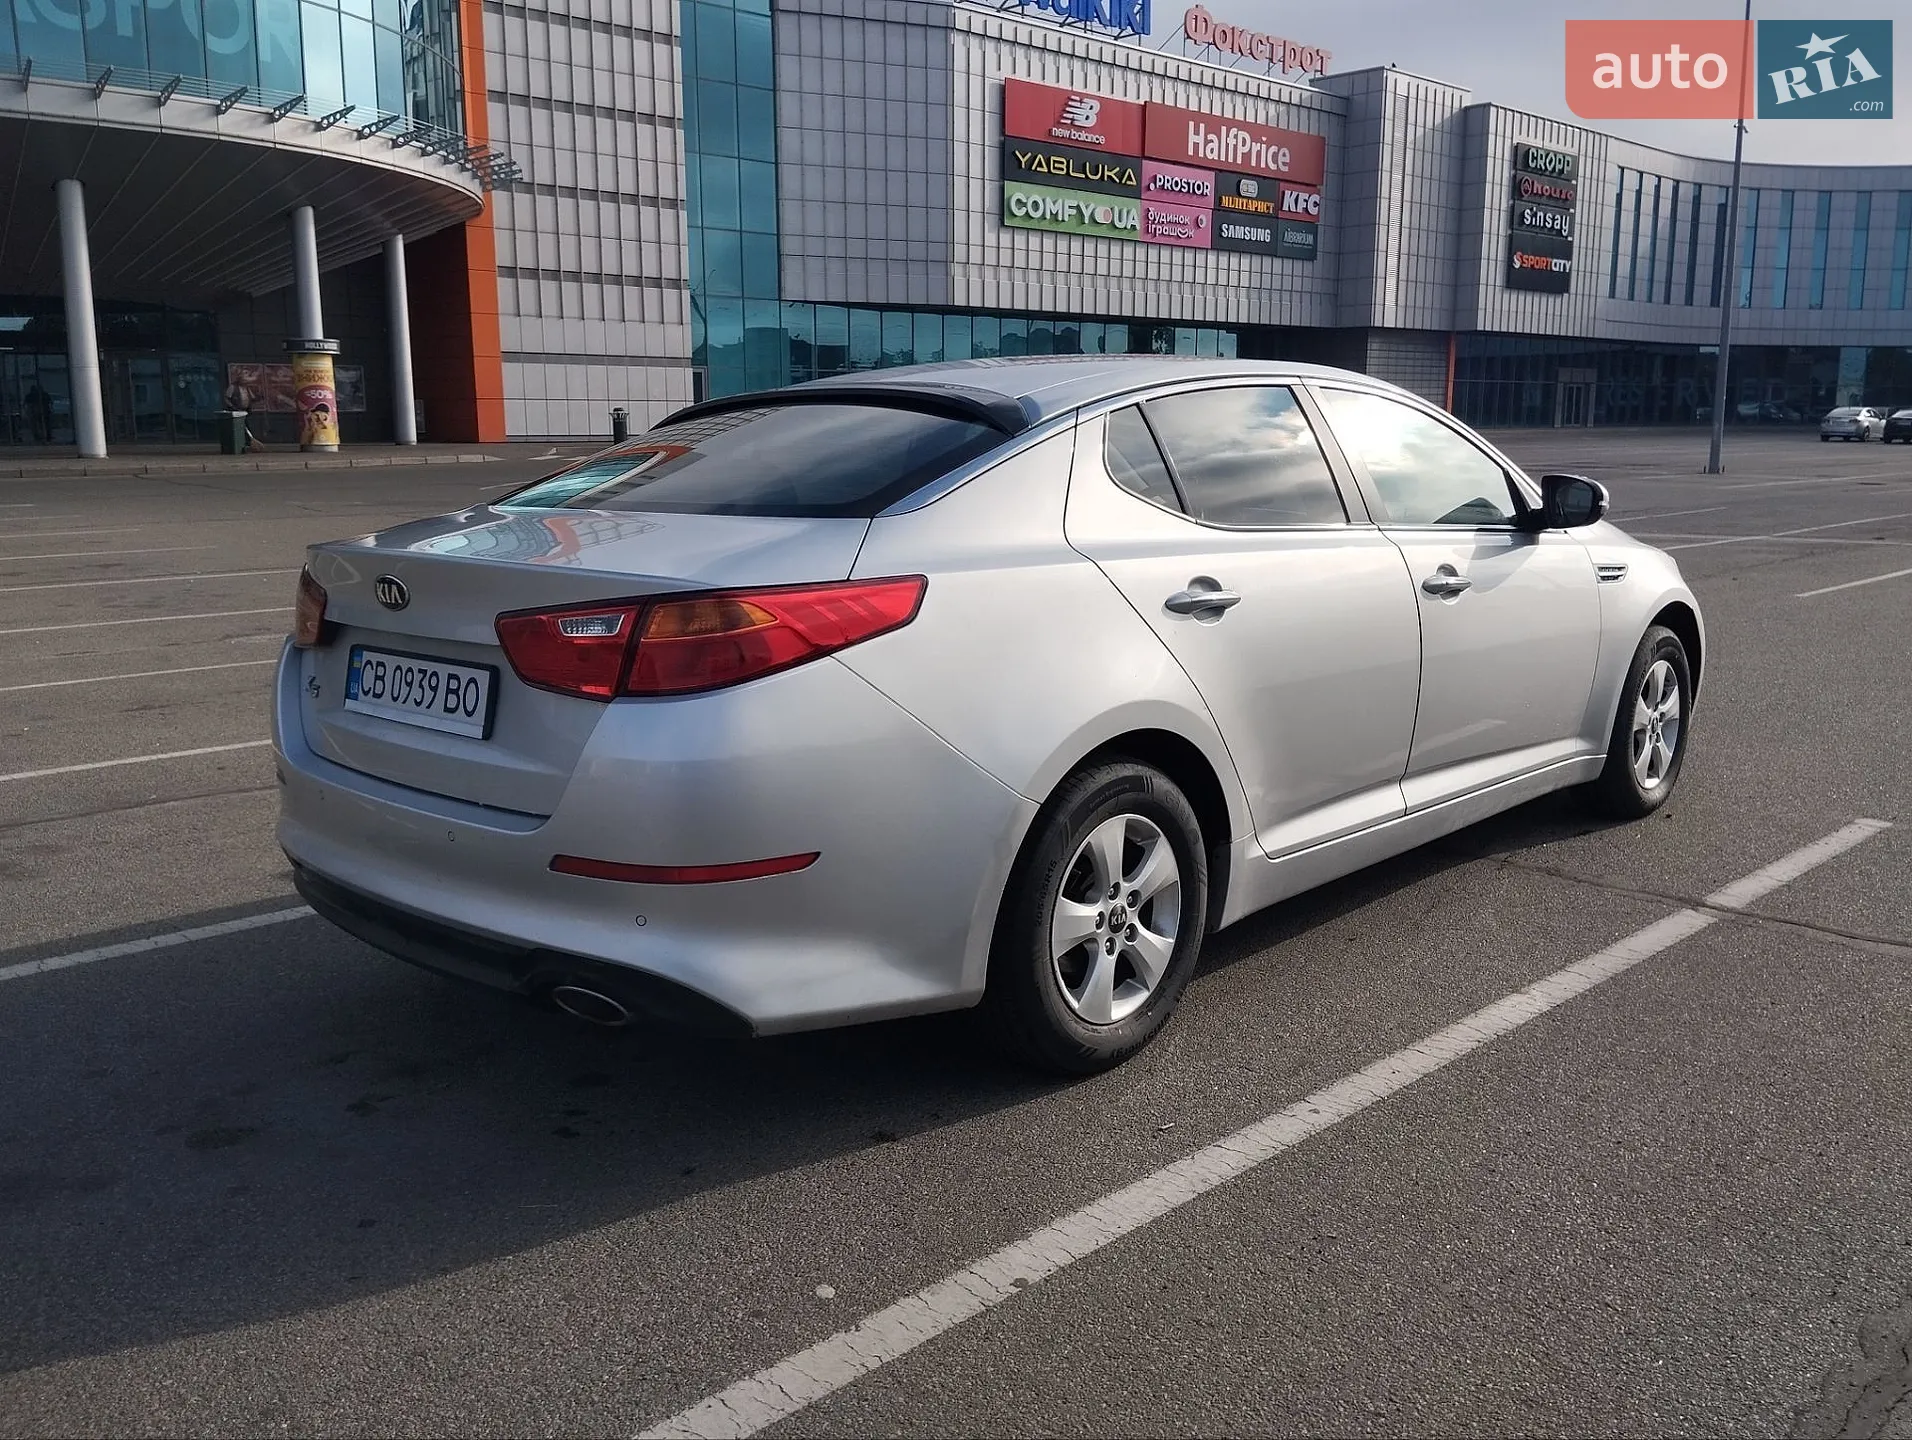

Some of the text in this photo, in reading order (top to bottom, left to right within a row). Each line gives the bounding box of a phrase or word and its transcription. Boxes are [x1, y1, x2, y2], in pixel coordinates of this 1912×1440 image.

[1184, 4, 1334, 76] Фокстрот
[1052, 127, 1106, 145] new balance
[1187, 120, 1290, 172] HalfPrice
[1015, 150, 1138, 186] YABLUKA
[1528, 148, 1572, 174] CROPP
[1148, 207, 1190, 225] будинок
[1282, 190, 1320, 216] KFC
[1221, 223, 1271, 243] SAMSUNG
[1524, 206, 1570, 236] sinsay
[376, 582, 403, 604] KIA
[360, 659, 480, 717] CB 0939 BO
[1110, 913, 1127, 926] KIA
